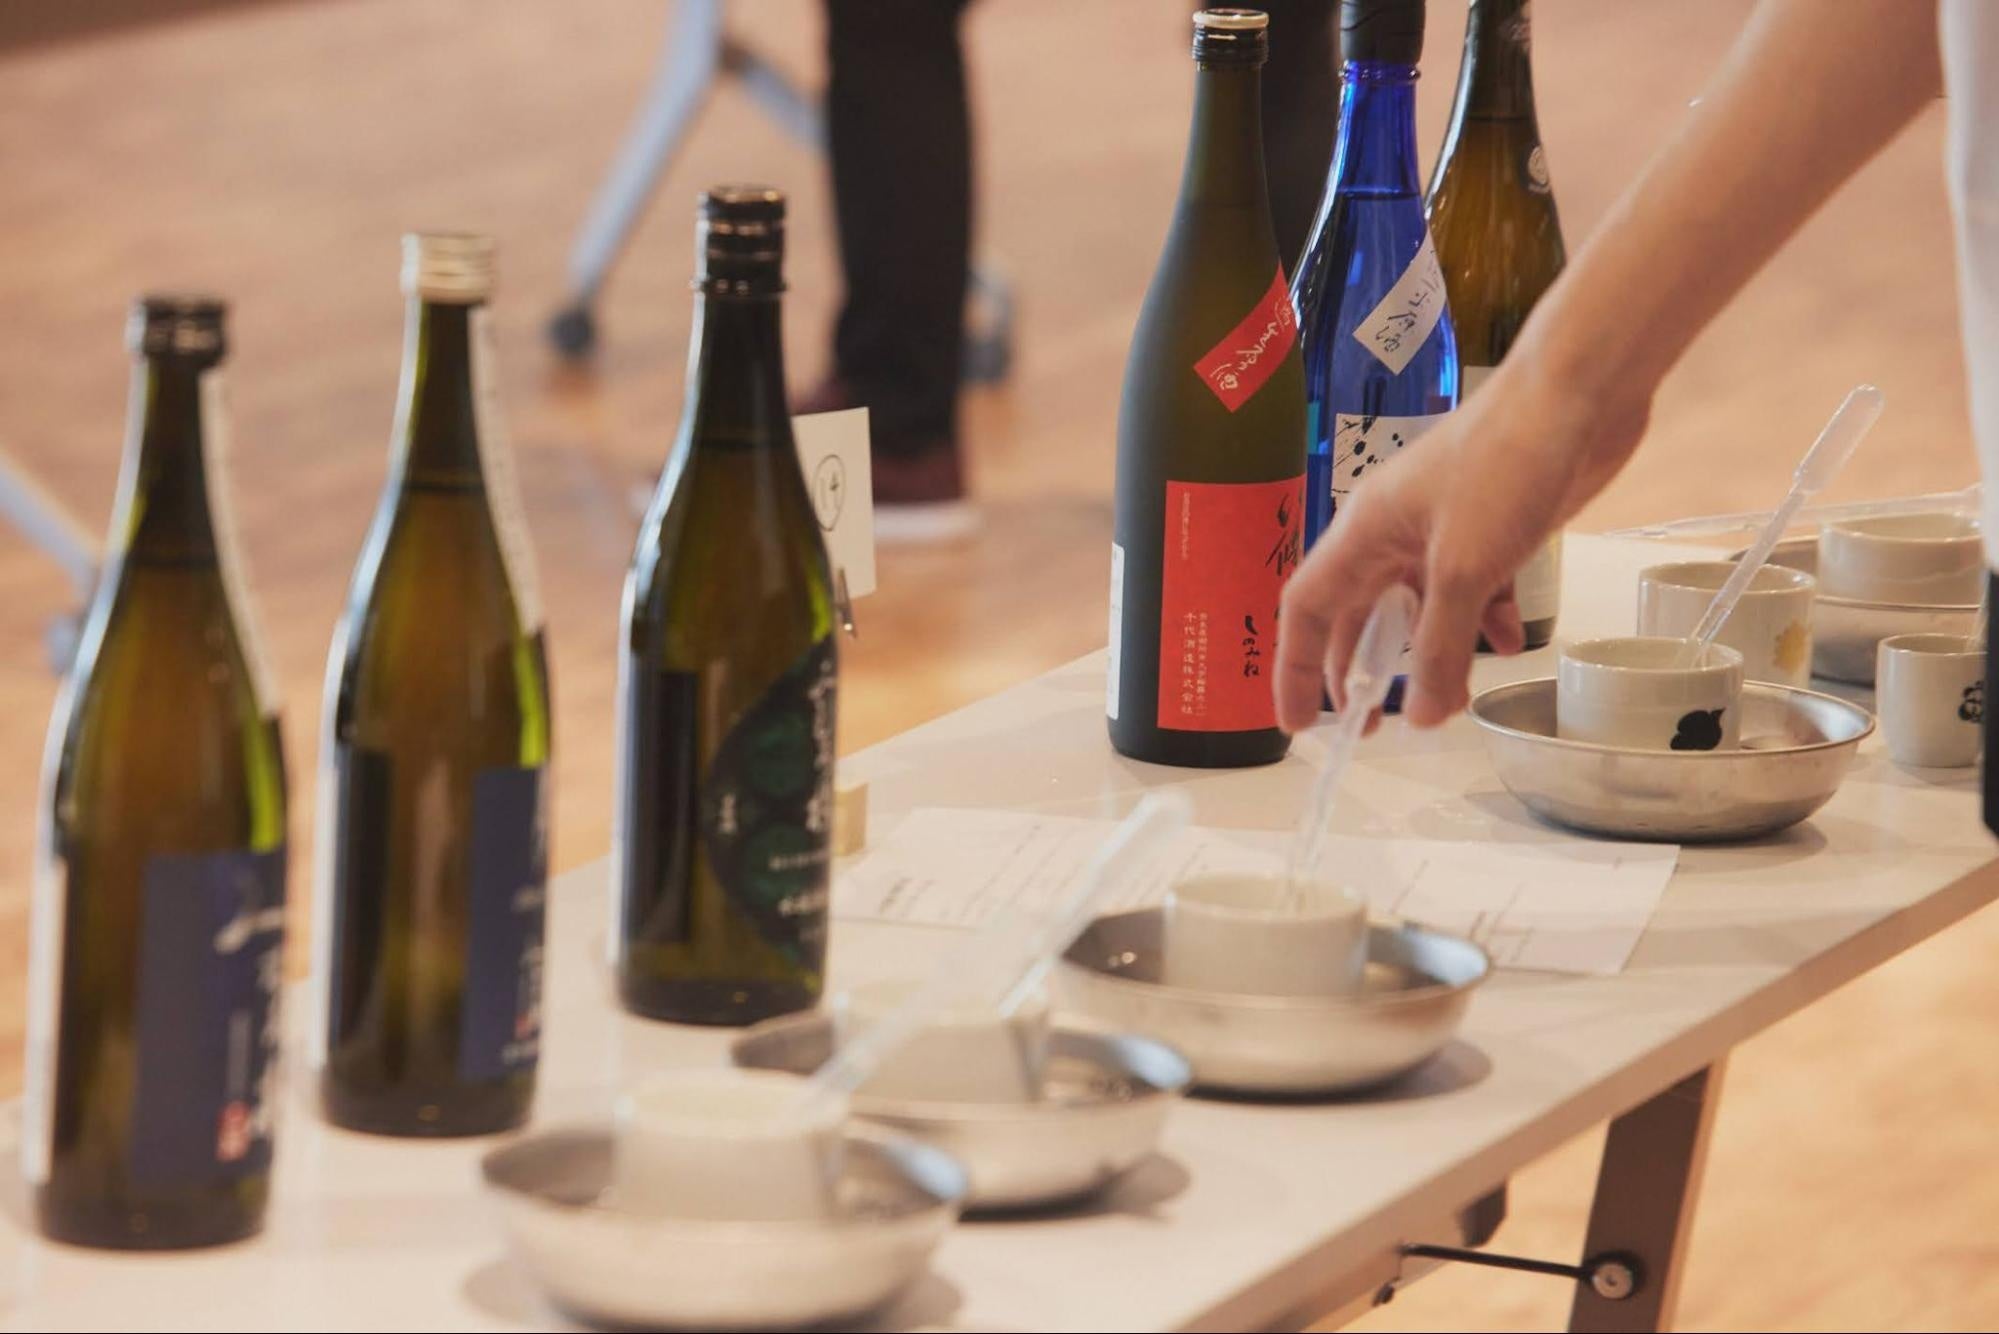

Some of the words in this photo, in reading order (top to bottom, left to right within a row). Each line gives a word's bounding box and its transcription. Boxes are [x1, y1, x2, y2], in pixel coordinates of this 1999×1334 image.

[1181, 612, 1197, 714] 千代酒造株式会社
[1242, 615, 1260, 678] しのみね
